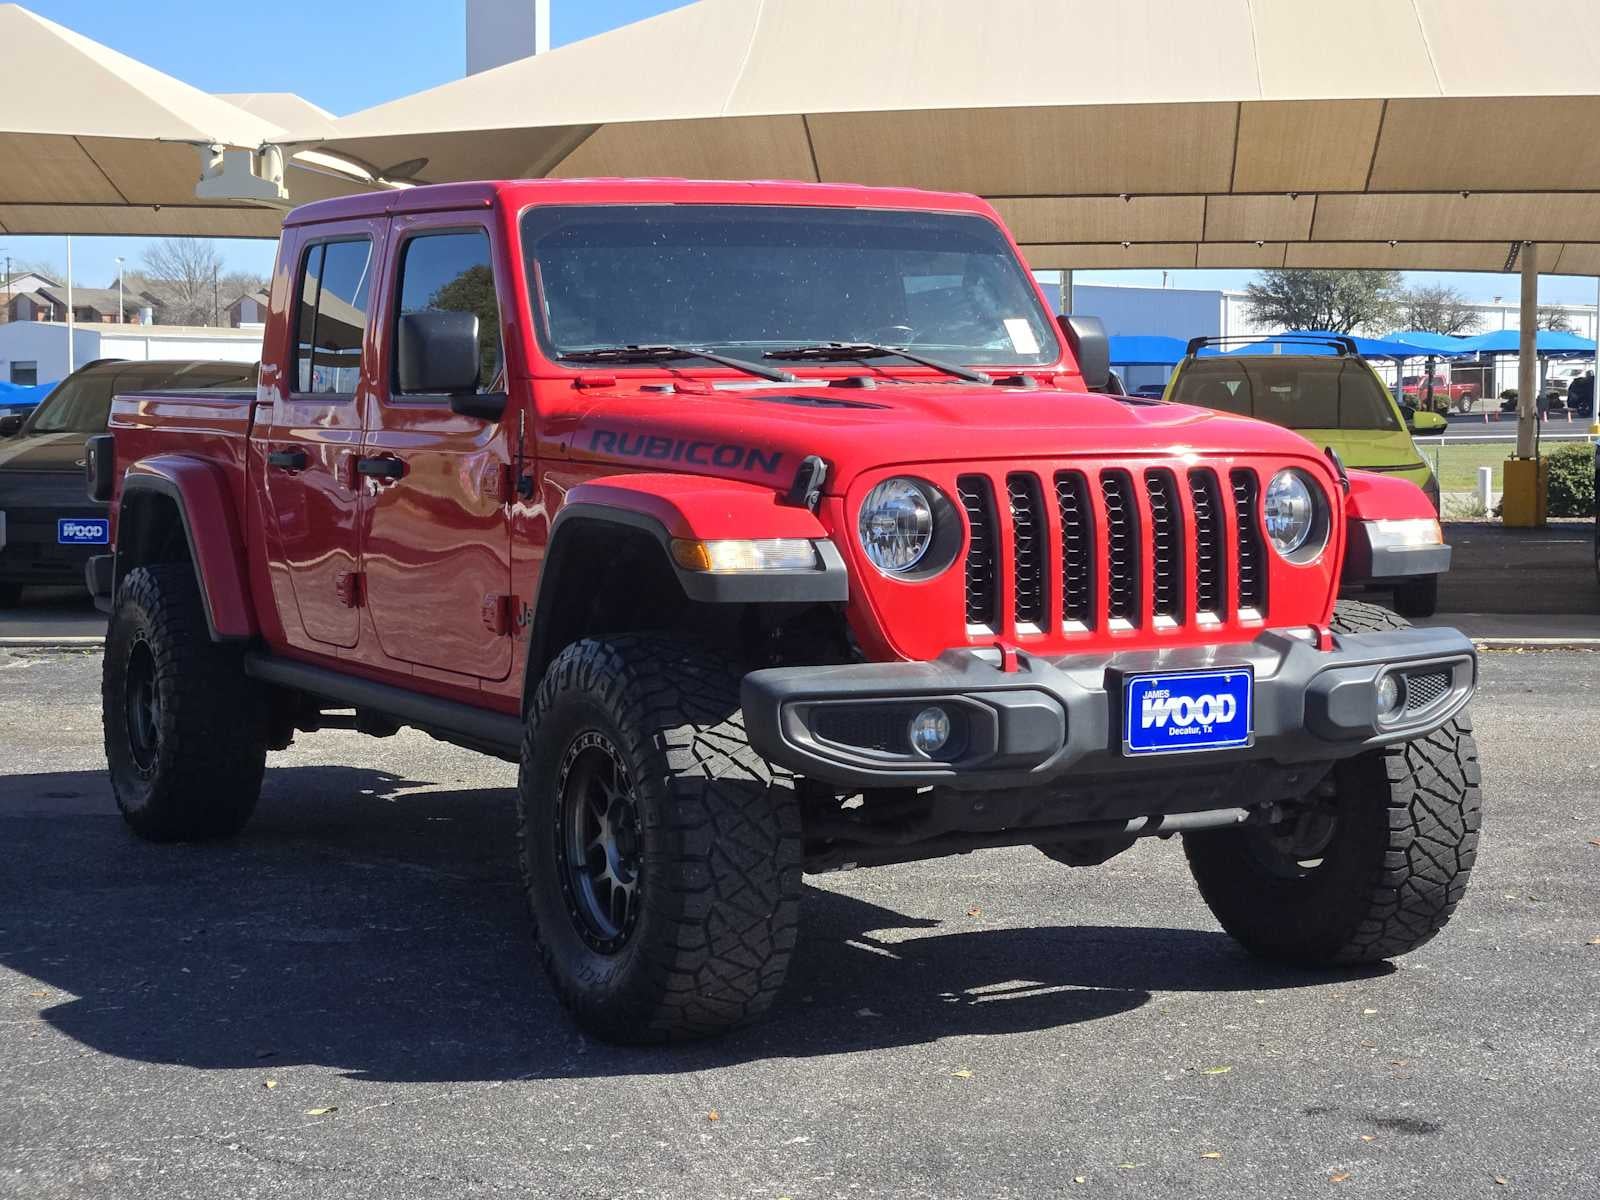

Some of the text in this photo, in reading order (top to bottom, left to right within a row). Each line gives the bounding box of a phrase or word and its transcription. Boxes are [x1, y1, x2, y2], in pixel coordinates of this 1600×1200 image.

[589, 429, 784, 474] RUBICON
[63, 525, 103, 537] WOOD
[1142, 689, 1170, 700] JAMES
[1141, 693, 1237, 729] WOOD
[1168, 724, 1213, 736] Decatur, Tx
